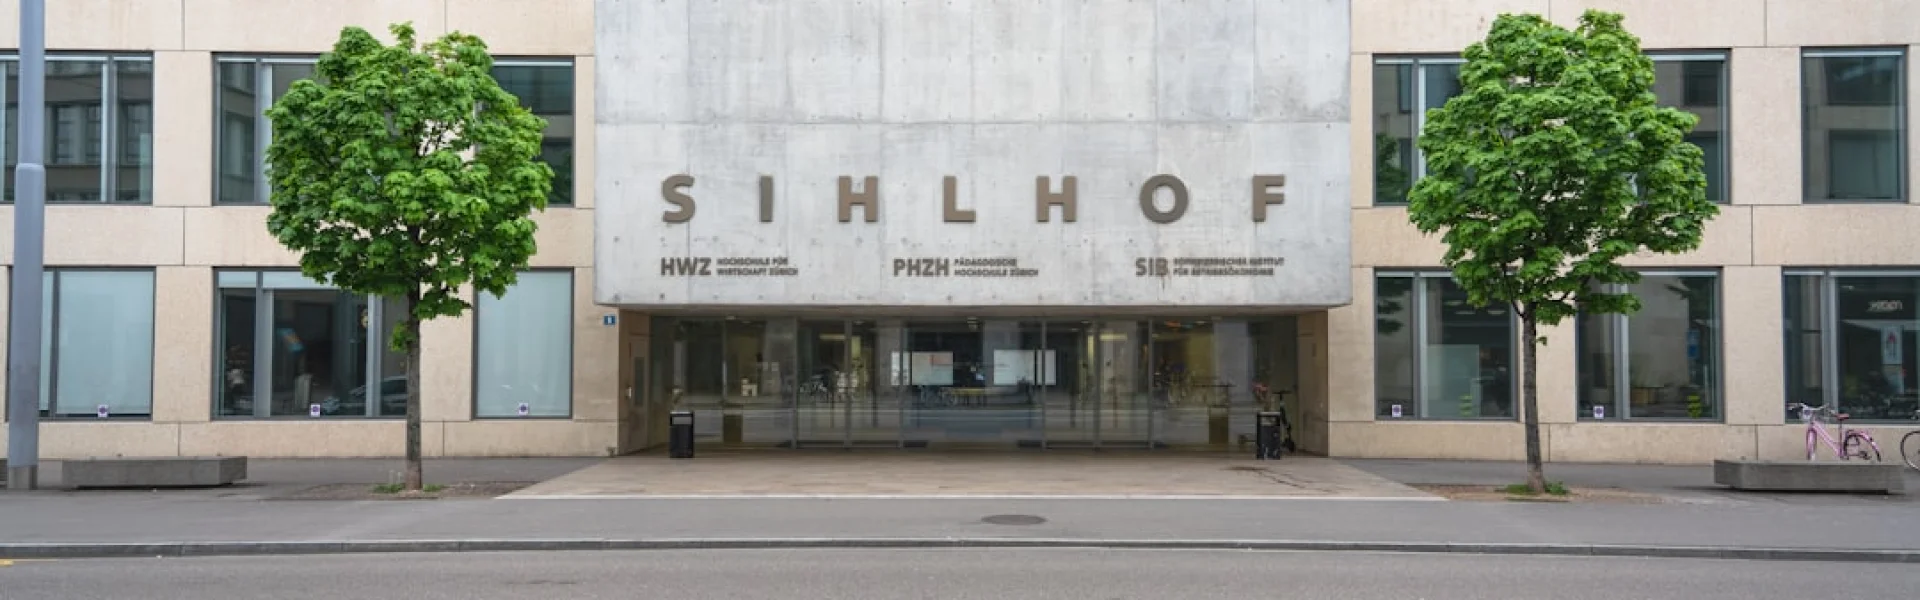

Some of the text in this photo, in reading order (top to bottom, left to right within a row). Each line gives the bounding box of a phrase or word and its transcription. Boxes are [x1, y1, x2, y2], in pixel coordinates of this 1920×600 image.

[661, 173, 1286, 224] SIHLHOF
[660, 257, 712, 276] HWZ
[893, 258, 949, 277] PHZH
[1135, 257, 1169, 276] SIB
